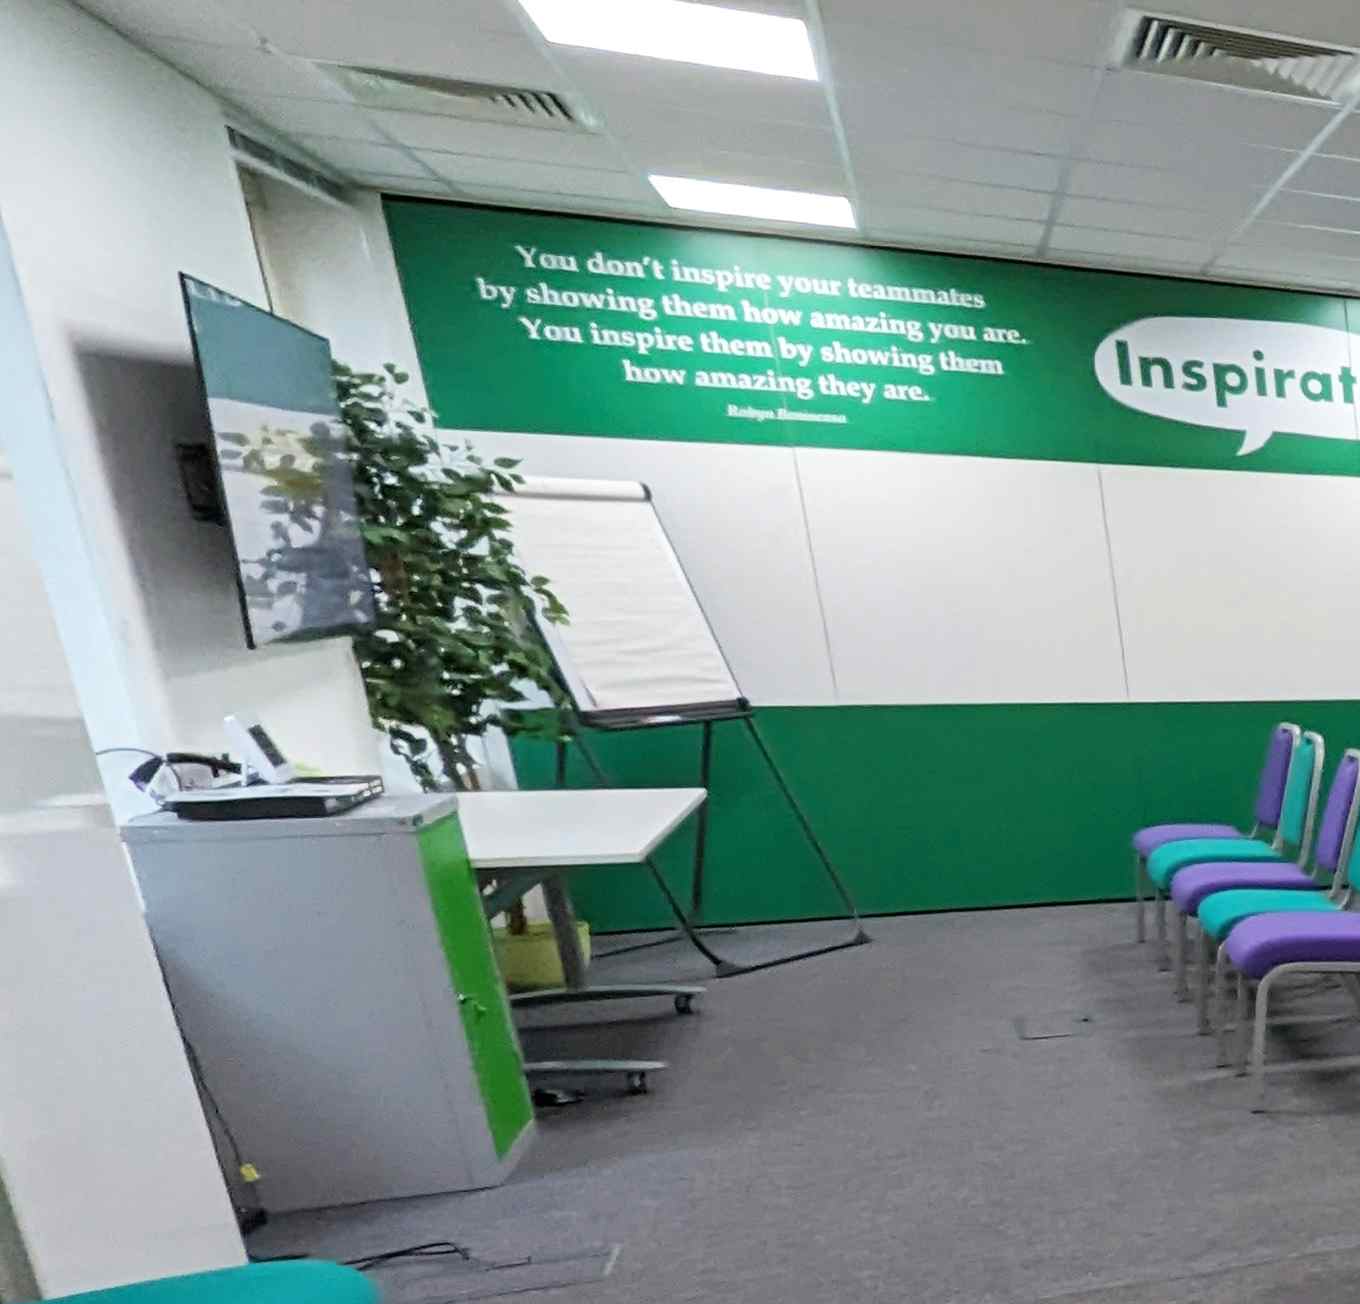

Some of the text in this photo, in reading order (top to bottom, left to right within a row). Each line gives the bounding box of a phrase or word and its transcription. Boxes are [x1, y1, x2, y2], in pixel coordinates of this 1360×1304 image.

[515, 245, 985, 308] You don't inspire your teammates
[475, 276, 1029, 344] by showing them how amazing you are.
[518, 315, 1004, 375] You inspire them by showing them
[622, 359, 931, 403] how amazing they are.
